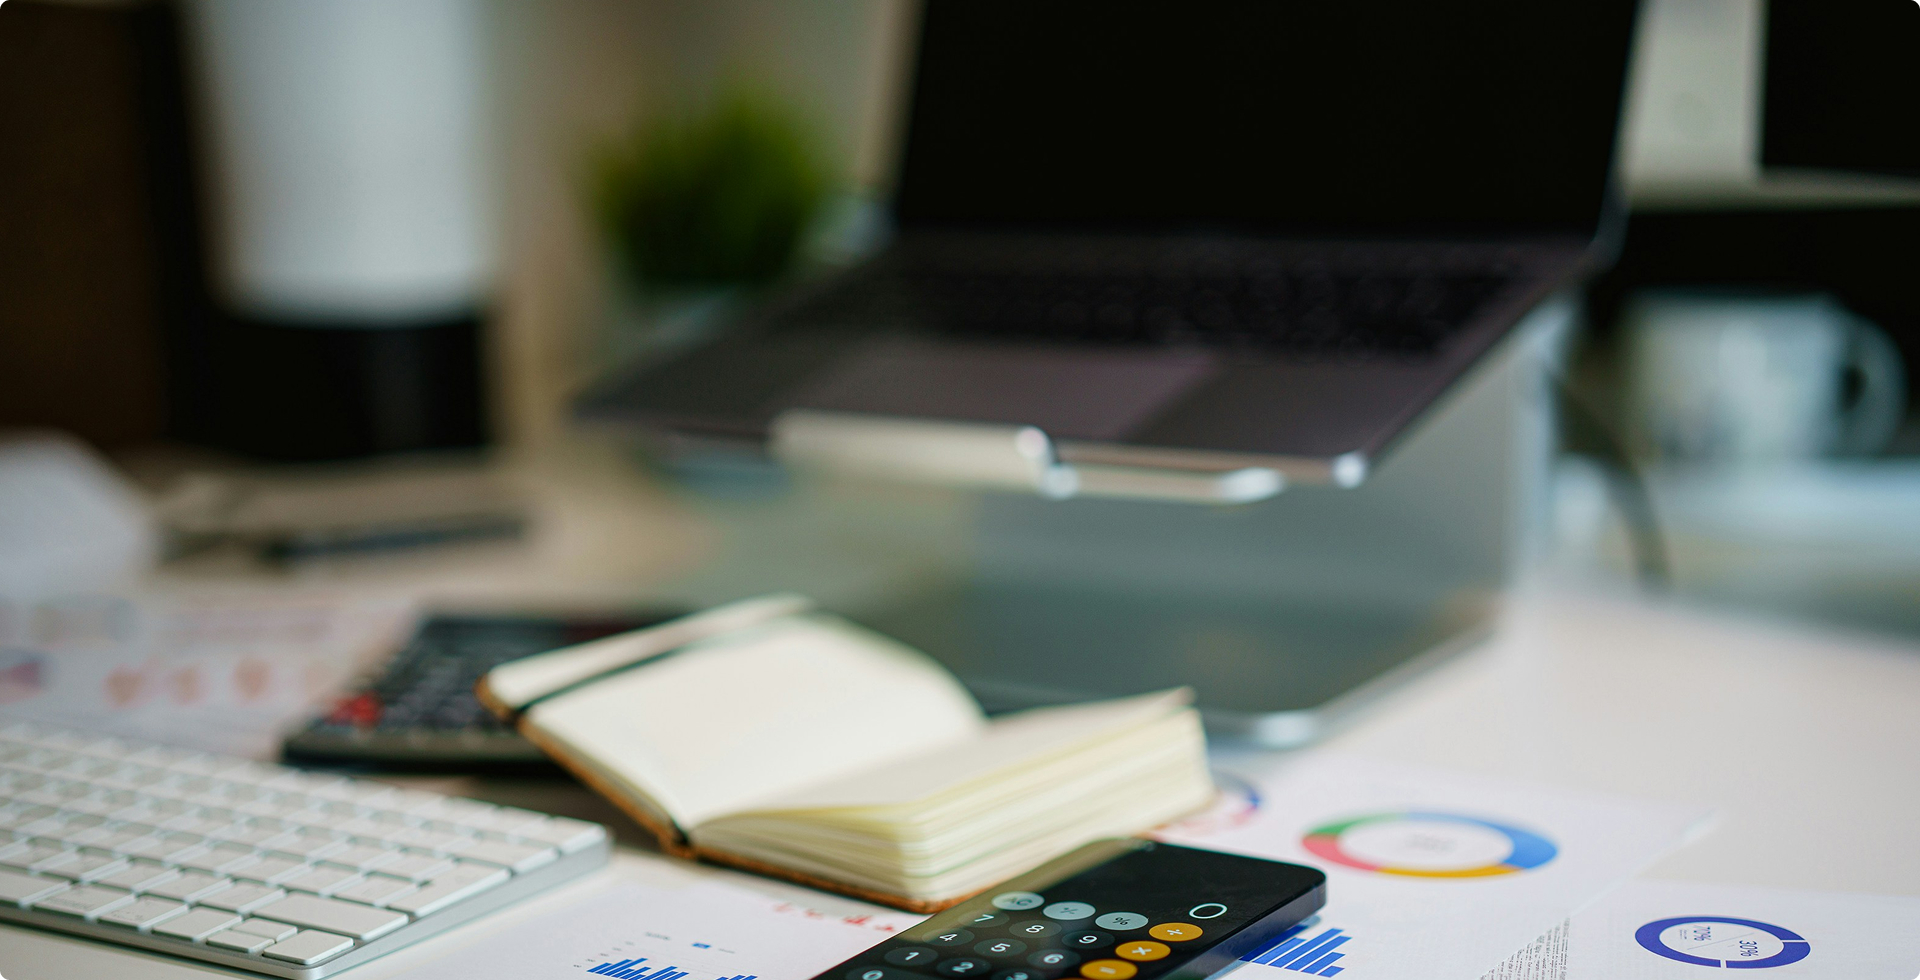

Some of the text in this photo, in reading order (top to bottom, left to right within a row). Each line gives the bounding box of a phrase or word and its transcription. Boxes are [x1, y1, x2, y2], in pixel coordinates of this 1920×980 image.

[1188, 903, 1228, 920] 0
[974, 914, 994, 922] 7
[1025, 924, 1045, 933] 8
[939, 933, 958, 942] 4
[1078, 935, 1098, 944] 9
[990, 943, 1011, 952] 5
[1739, 940, 1759, 957] 30%
[905, 951, 919, 961] 1
[1043, 953, 1064, 964] 6
[951, 962, 974, 973] 2
[862, 970, 884, 980] 0
